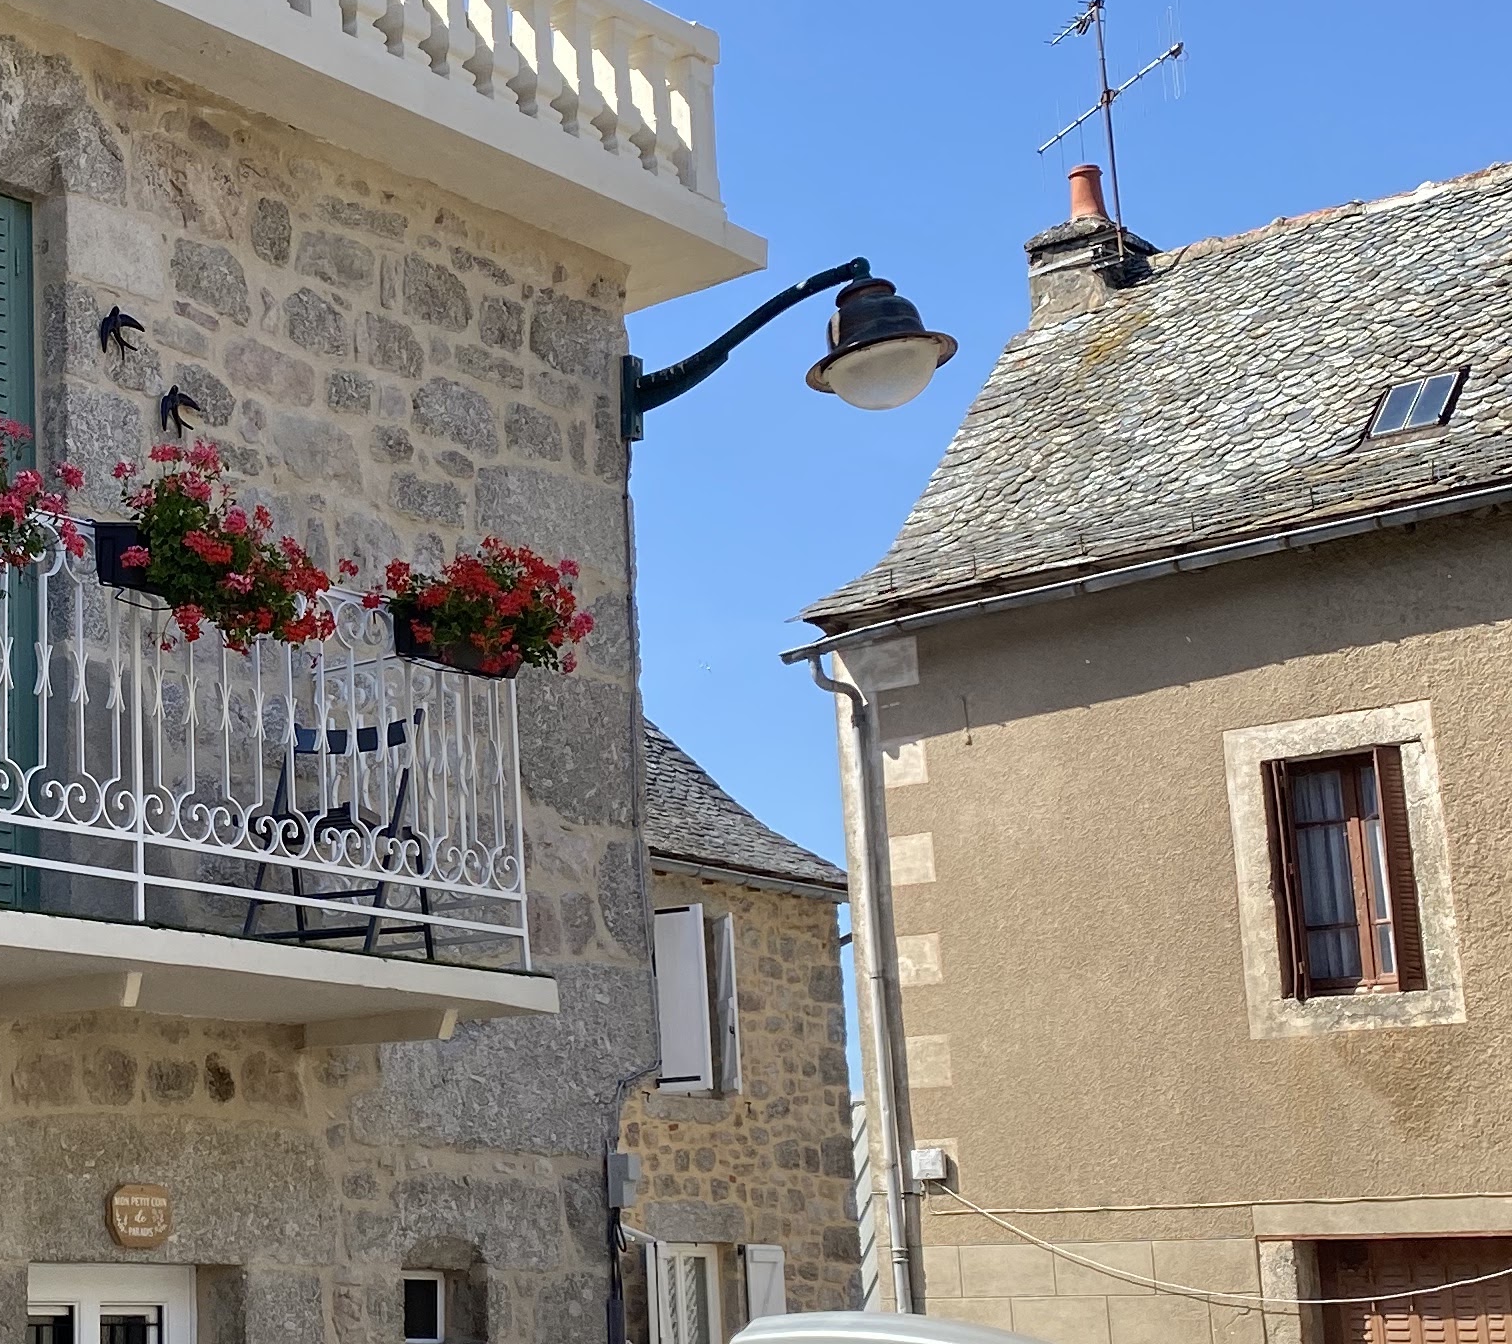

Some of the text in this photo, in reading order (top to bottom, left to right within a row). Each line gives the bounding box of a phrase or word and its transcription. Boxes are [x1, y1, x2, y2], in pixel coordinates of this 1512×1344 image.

[114, 1196, 167, 1207] MON PETIT COIN
[134, 1209, 147, 1223] de
[128, 1226, 154, 1237] PARADIS
